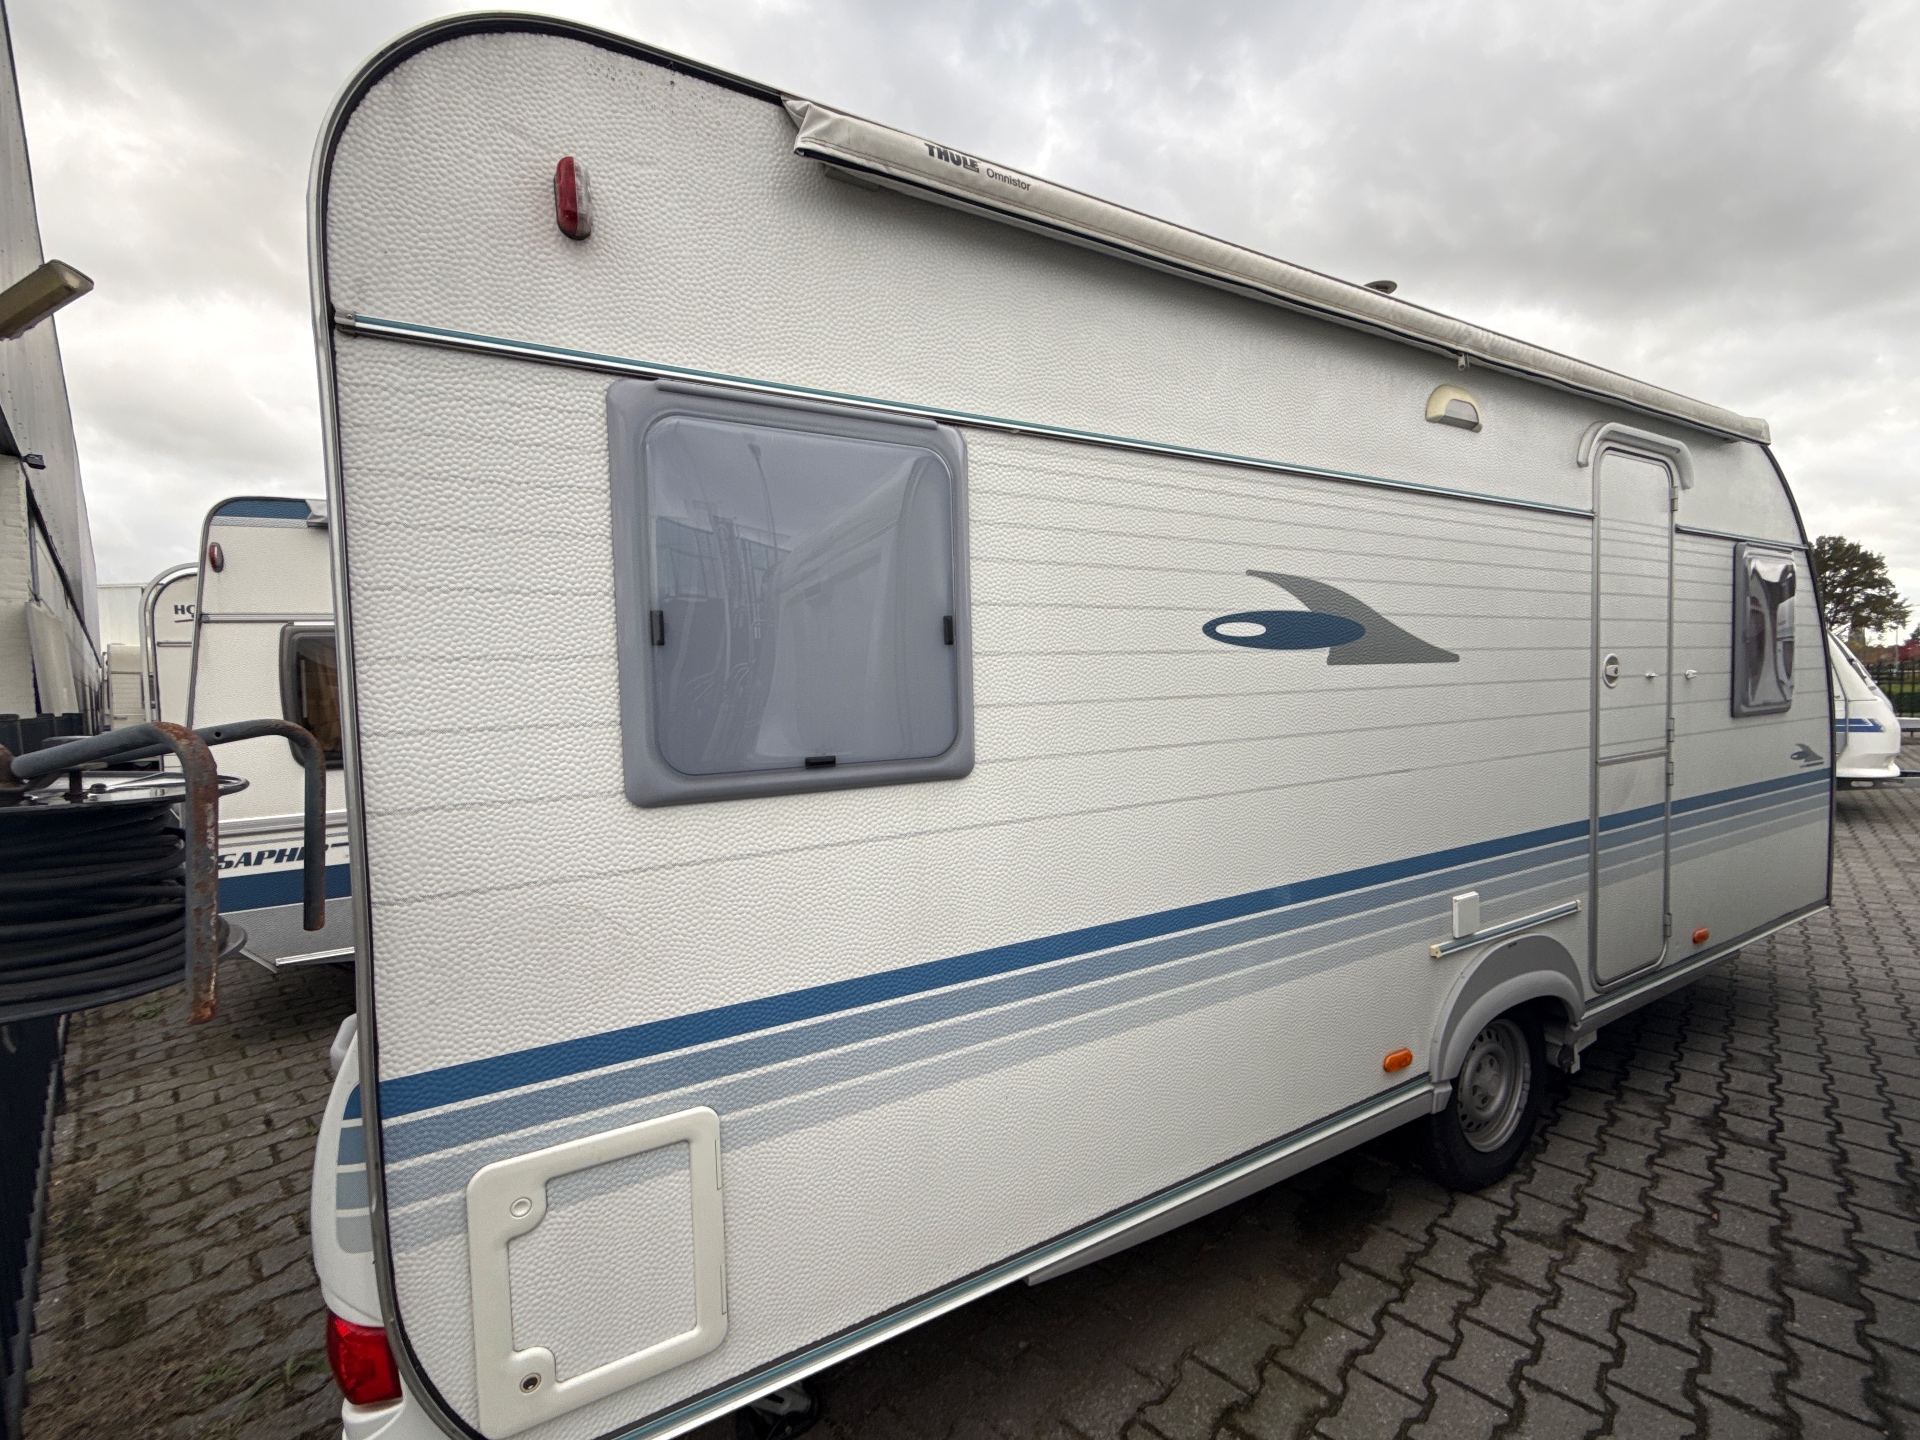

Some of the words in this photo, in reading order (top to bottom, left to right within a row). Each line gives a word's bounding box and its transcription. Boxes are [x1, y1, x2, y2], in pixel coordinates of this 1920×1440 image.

[924, 142, 979, 173] THULE
[986, 168, 1031, 191] Omnistor
[217, 844, 328, 870] SAPHI
